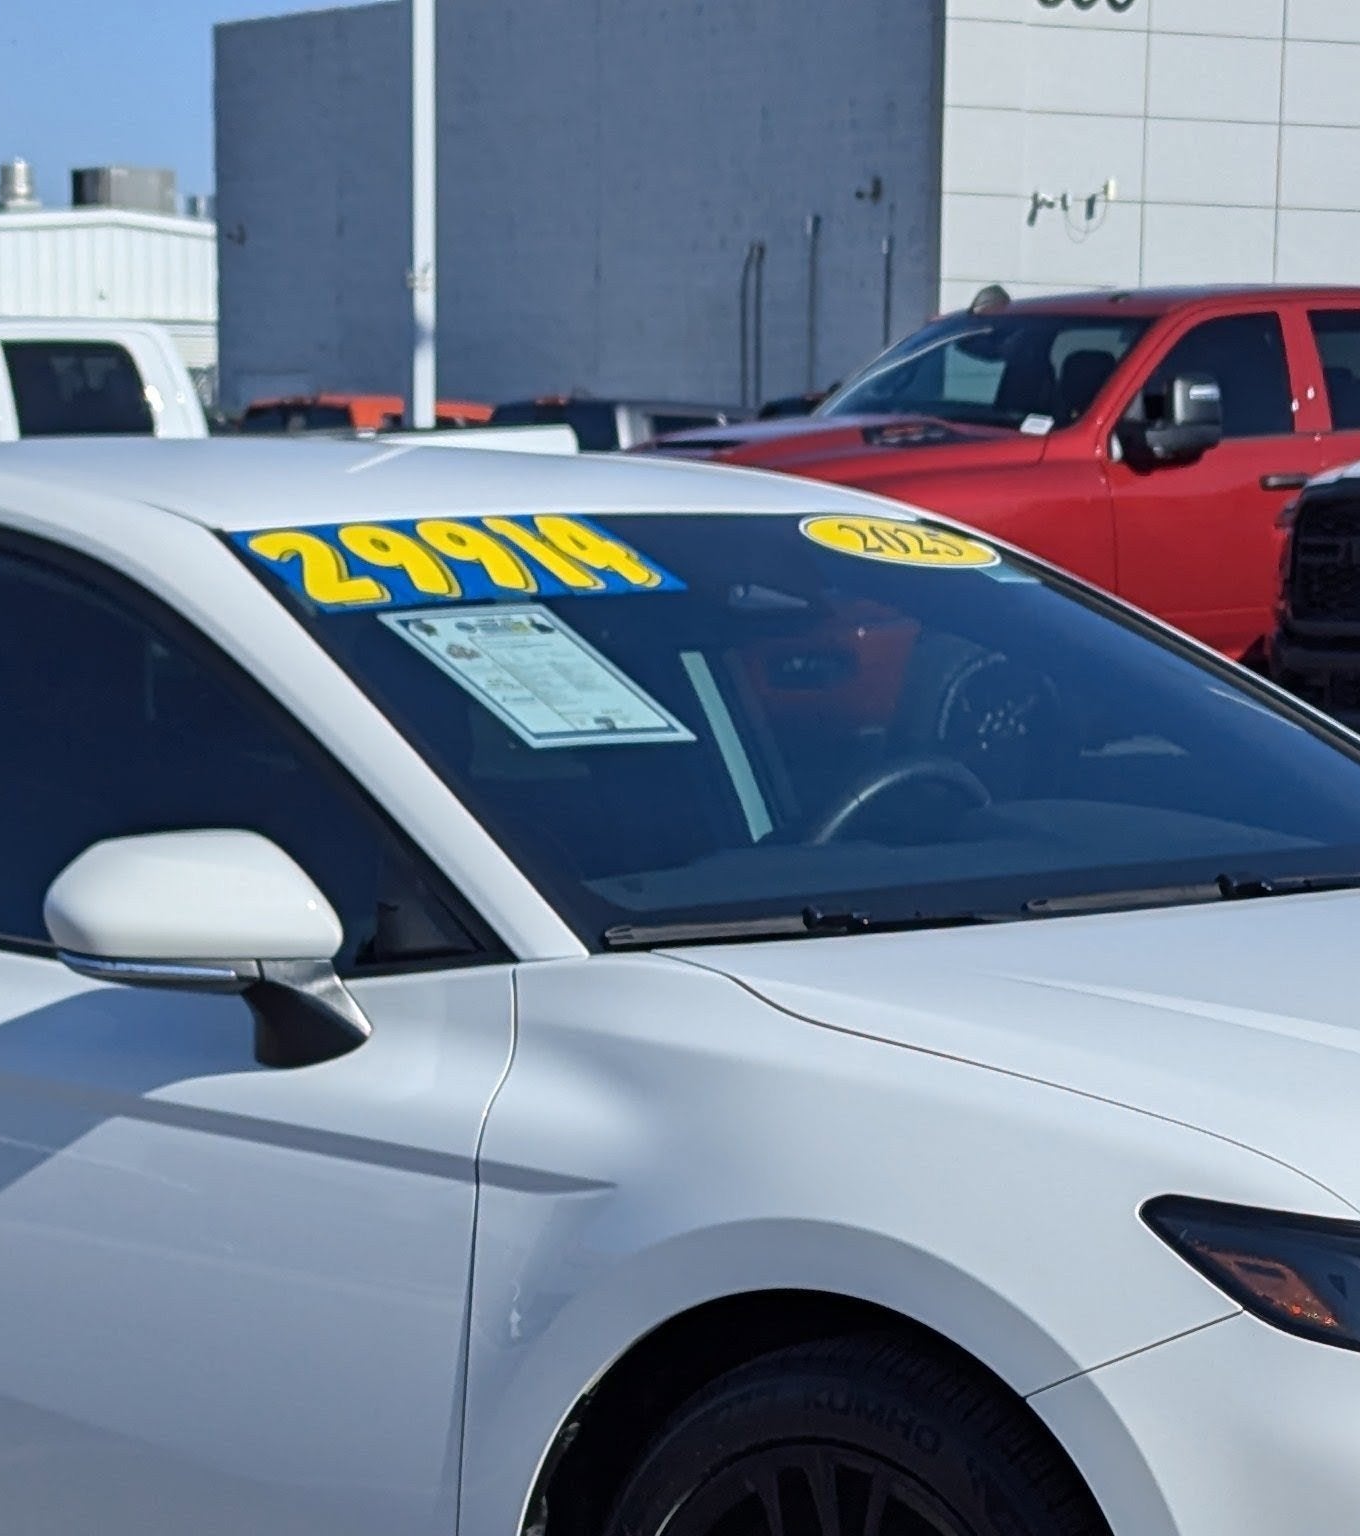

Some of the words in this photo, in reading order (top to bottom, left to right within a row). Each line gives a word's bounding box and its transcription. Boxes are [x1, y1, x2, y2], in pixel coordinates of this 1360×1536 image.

[248, 514, 661, 604] 29914
[837, 523, 964, 557] 2025
[802, 1383, 943, 1456] KUMHO
